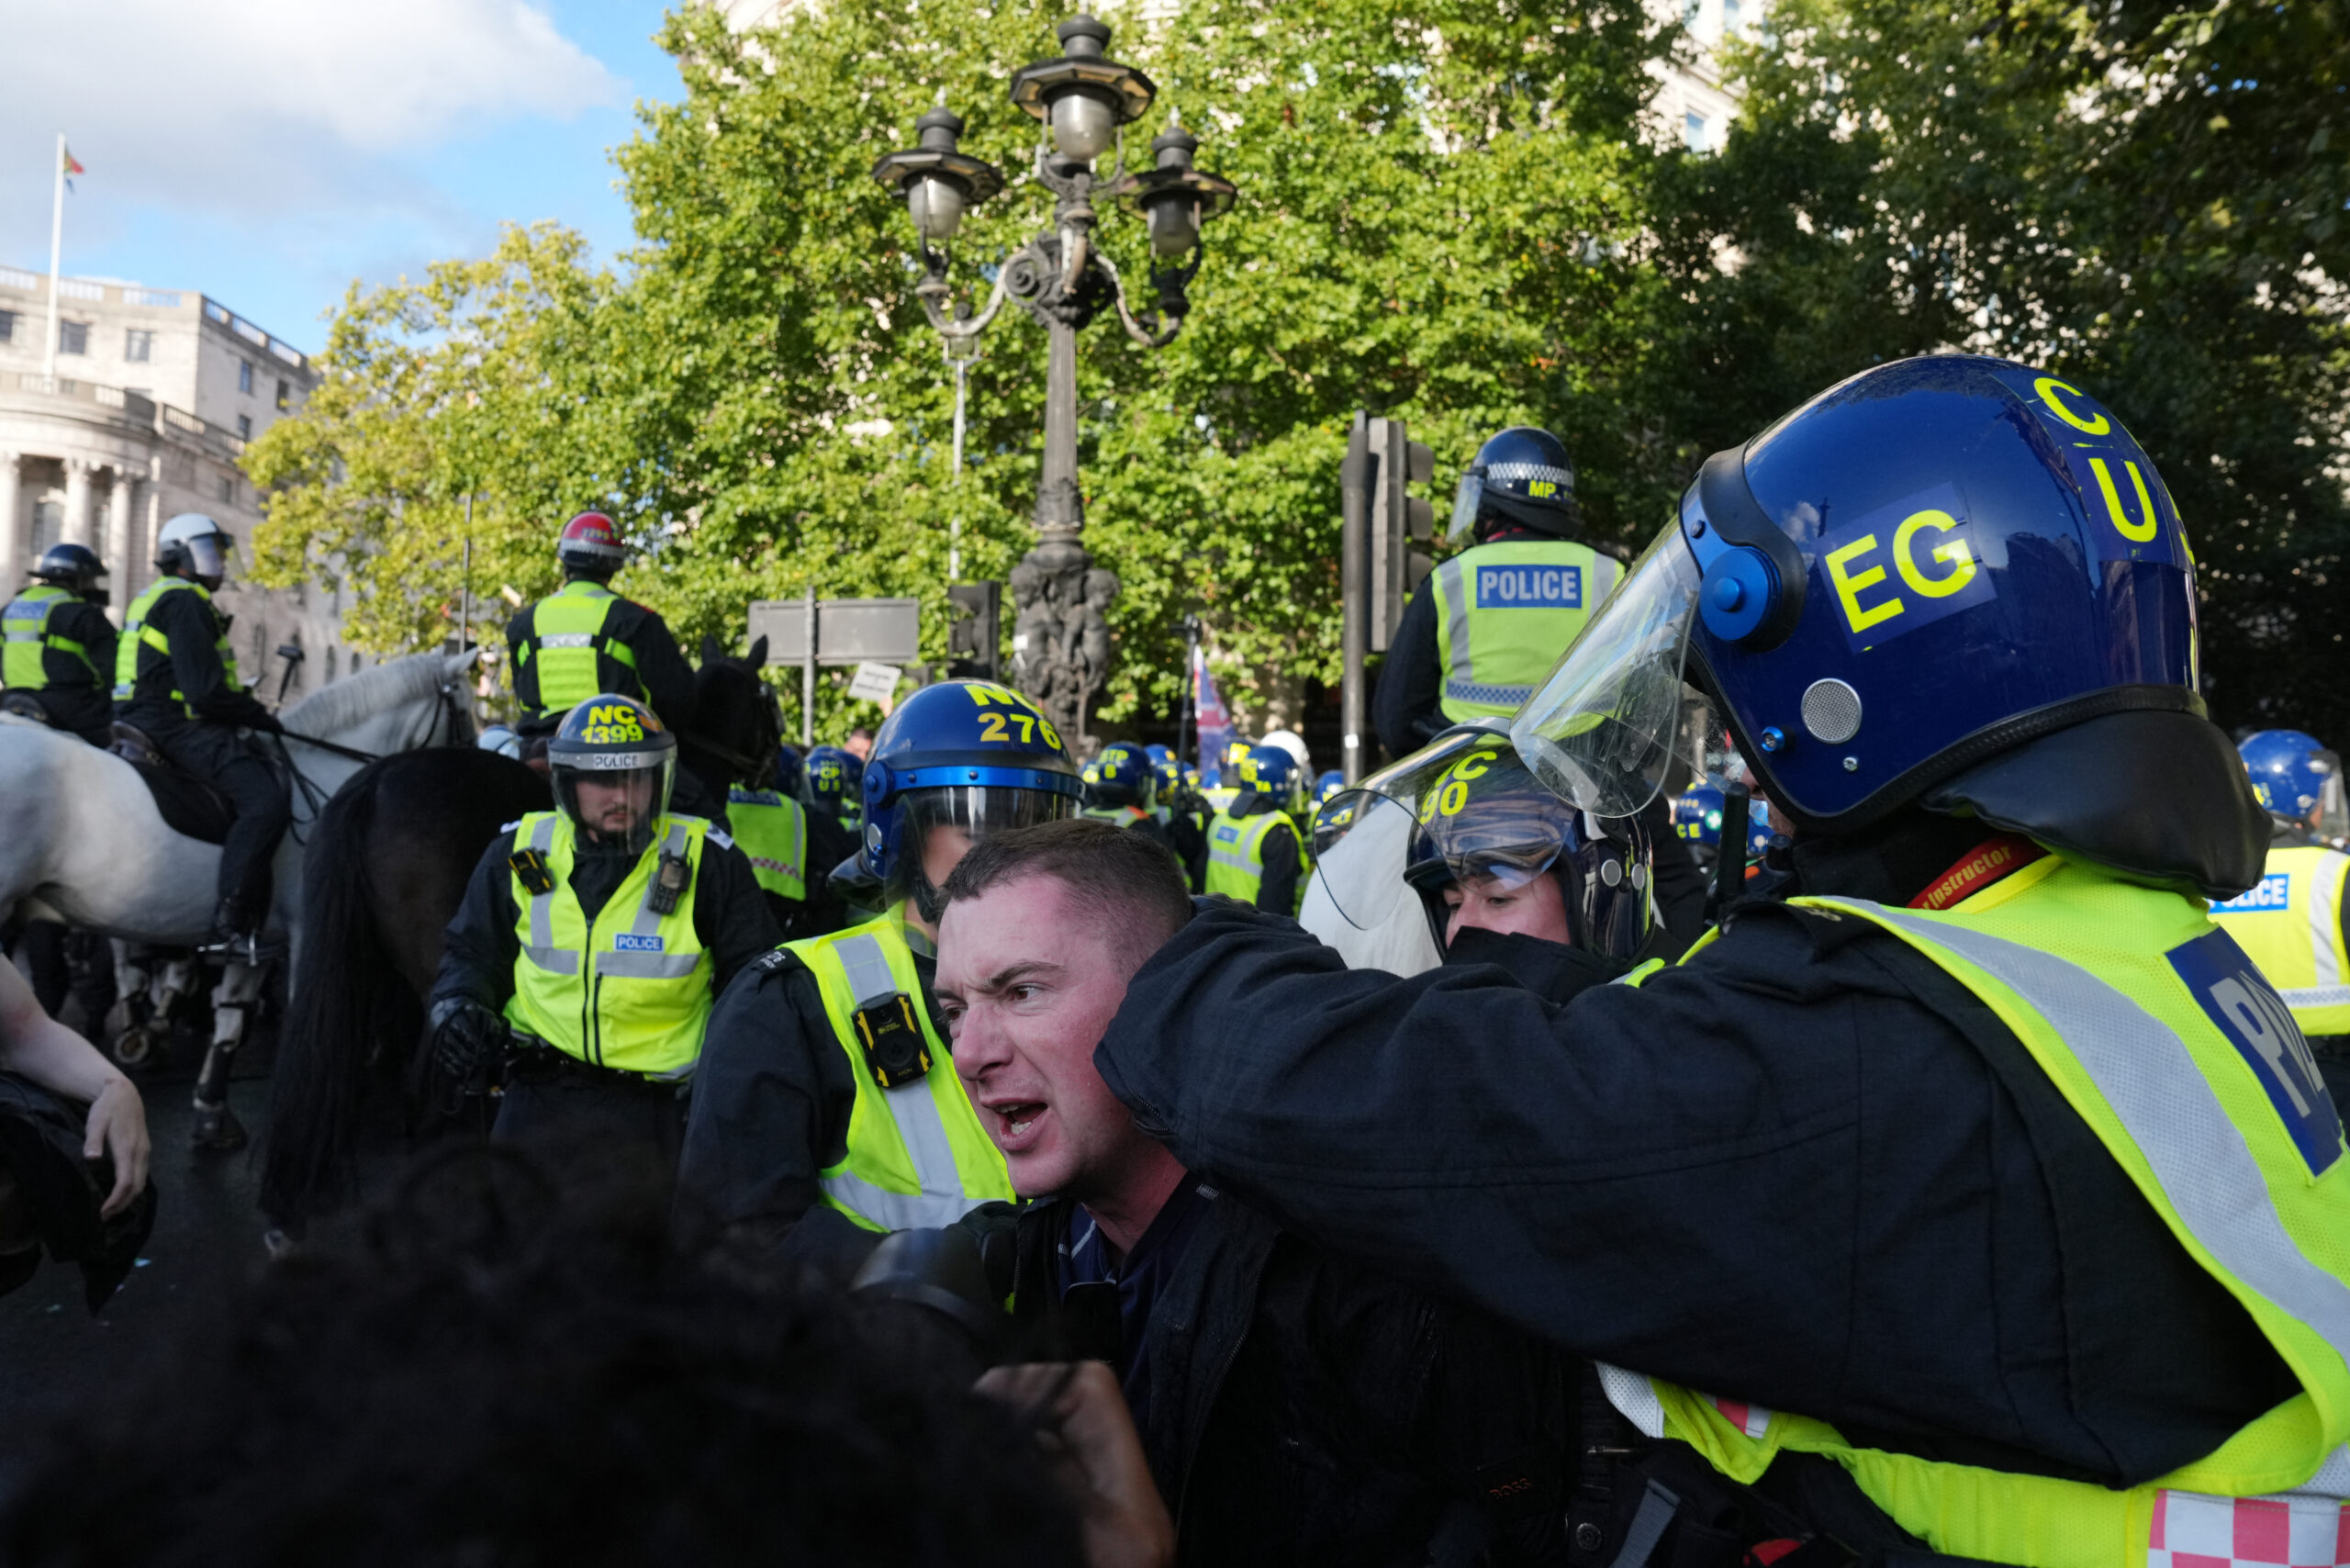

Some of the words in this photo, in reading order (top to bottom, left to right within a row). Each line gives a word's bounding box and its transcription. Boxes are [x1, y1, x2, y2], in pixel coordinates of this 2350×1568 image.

[1529, 480, 1557, 498] MP
[2087, 457, 2158, 543] U
[1481, 570, 1578, 600] POLICE
[1824, 509, 1977, 633] EG
[588, 705, 637, 725] NC
[581, 723, 644, 745] 1399
[978, 712, 1062, 750] 276
[595, 755, 639, 767] POLICE
[1418, 780, 1469, 824] 90
[1928, 846, 2011, 909] Instructor
[617, 935, 661, 950] POLICE
